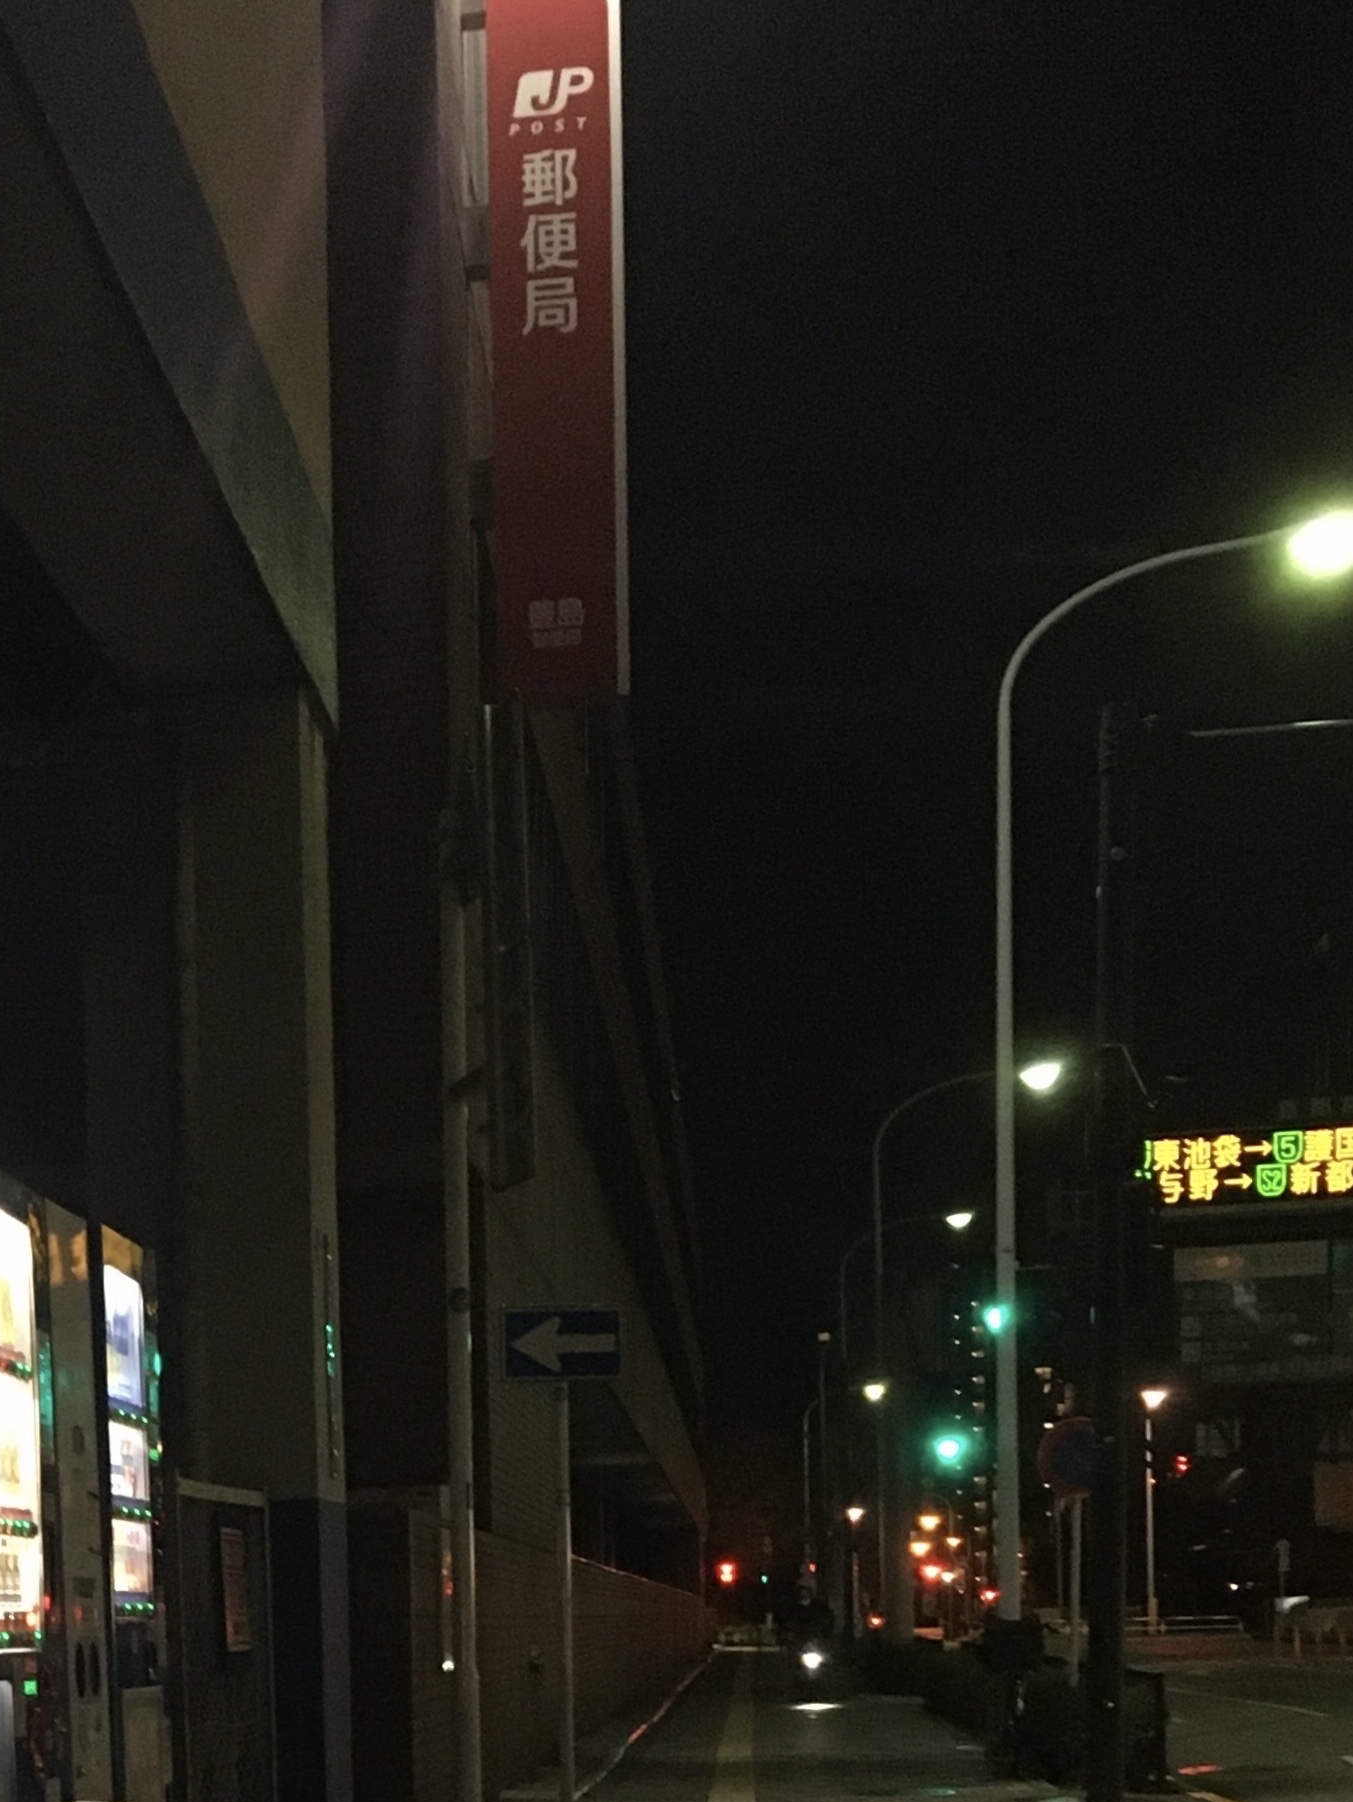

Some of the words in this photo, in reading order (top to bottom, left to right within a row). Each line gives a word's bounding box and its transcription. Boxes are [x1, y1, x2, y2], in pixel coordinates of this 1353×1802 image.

[513, 66, 594, 118] JP
[509, 116, 588, 137] POST
[520, 148, 579, 336] 郵便局
[1153, 1134, 1242, 1171] 東池袋
[1160, 1168, 1218, 1204] 与野
